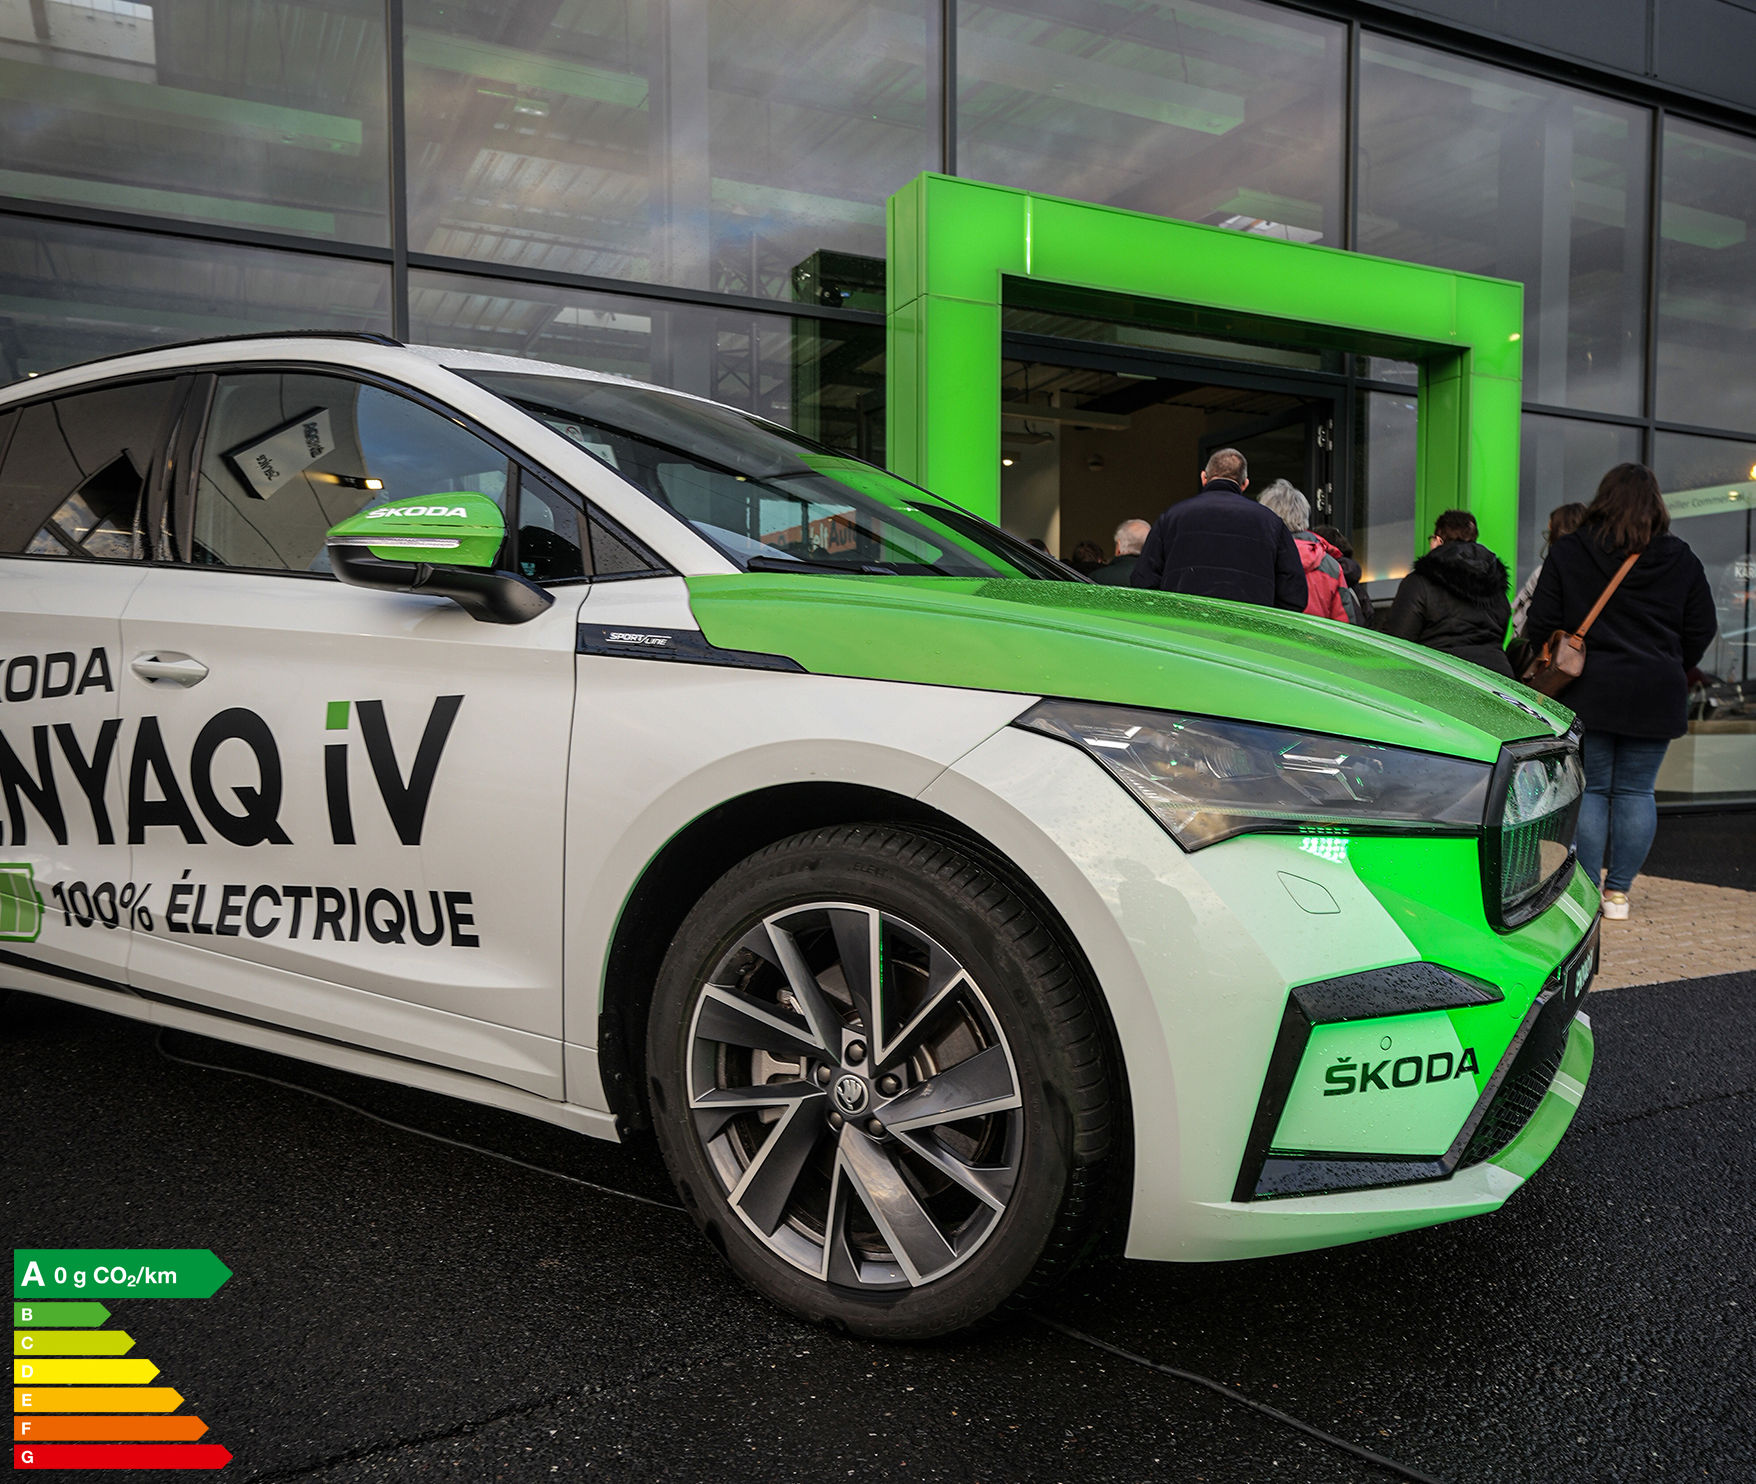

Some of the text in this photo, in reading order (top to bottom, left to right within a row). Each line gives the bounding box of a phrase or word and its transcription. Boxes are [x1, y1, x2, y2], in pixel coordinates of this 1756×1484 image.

[0, 647, 114, 702] ODA
[0, 694, 465, 846] NYAQ iV
[52, 869, 481, 948] 100% ÉLECTRIQUE
[1323, 1047, 1480, 1097] ŠKODA
